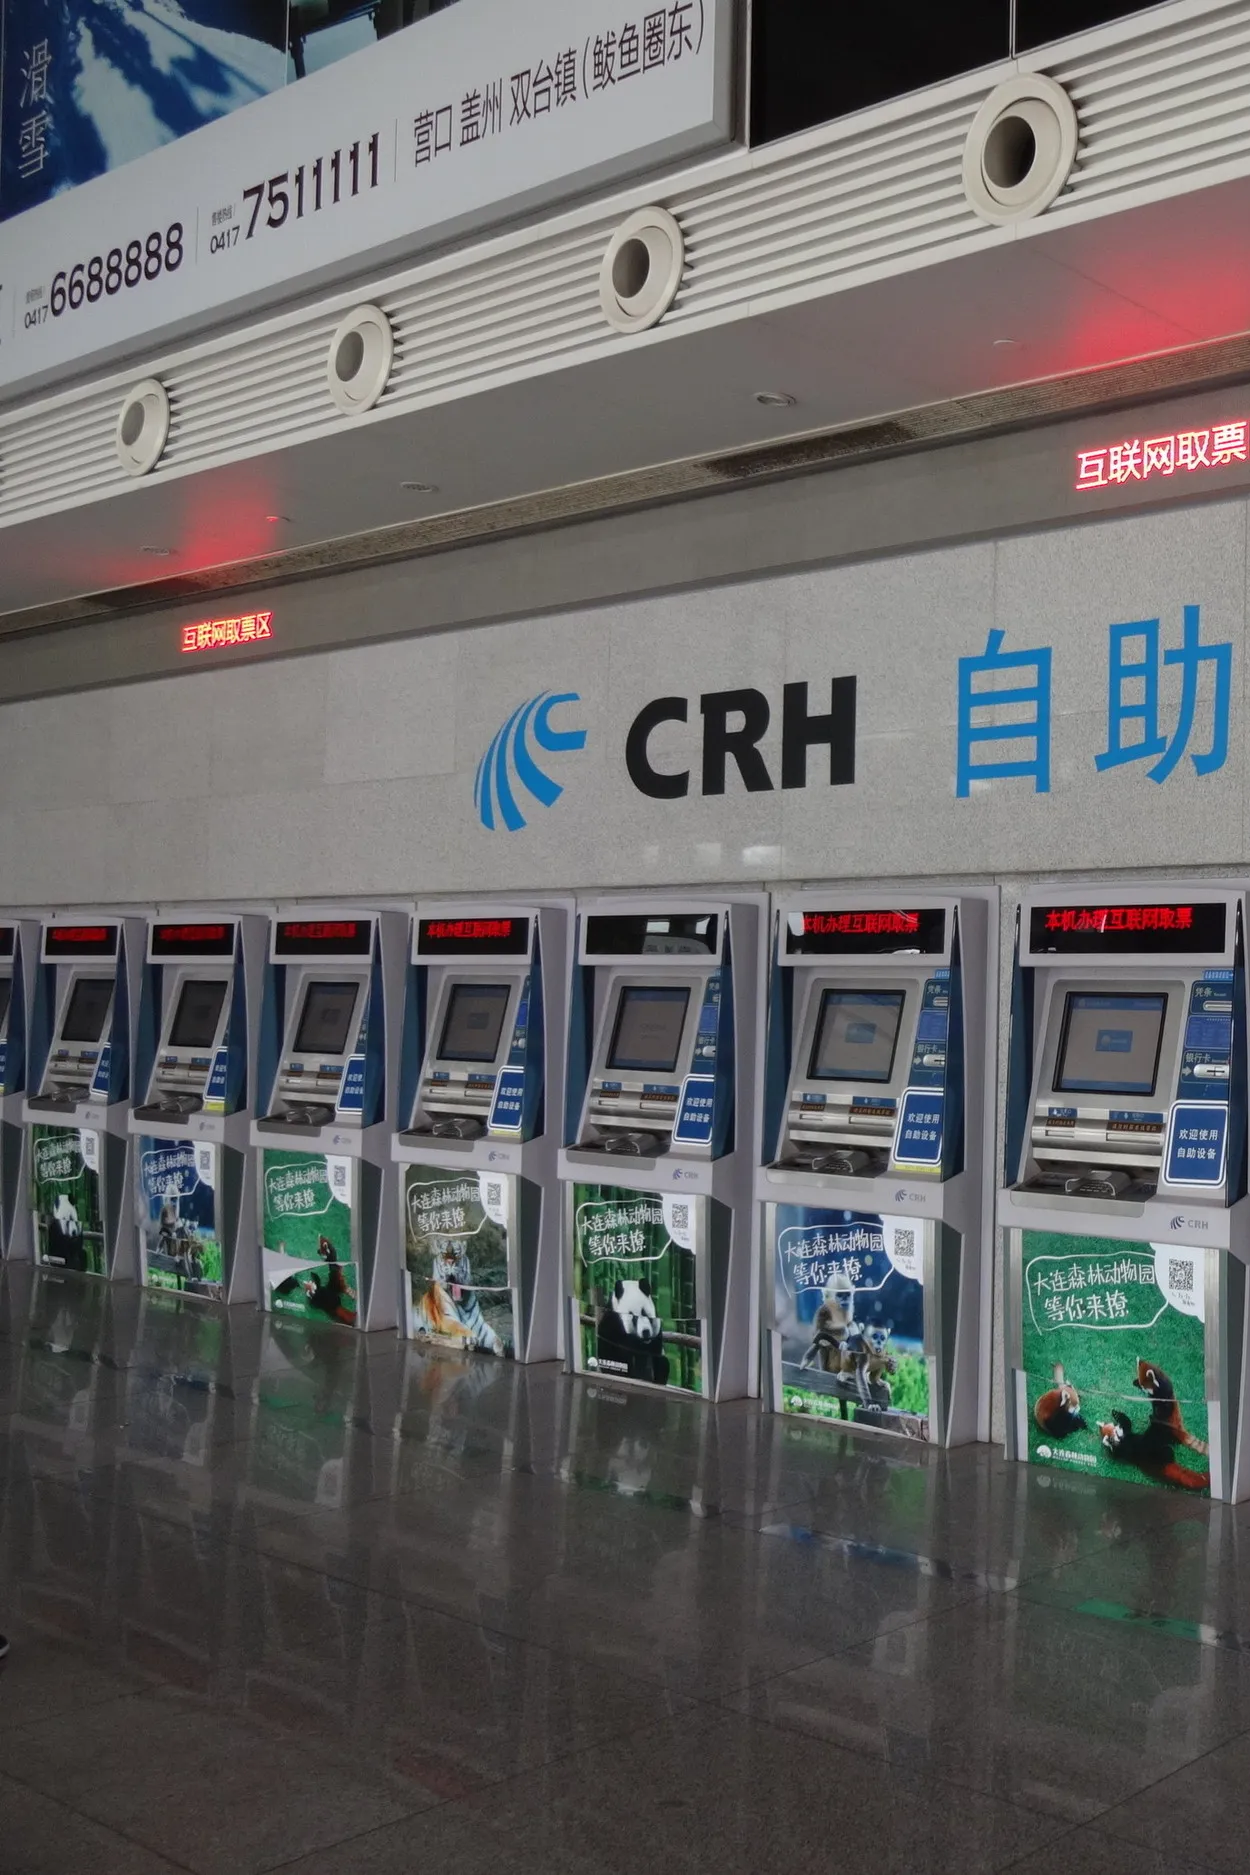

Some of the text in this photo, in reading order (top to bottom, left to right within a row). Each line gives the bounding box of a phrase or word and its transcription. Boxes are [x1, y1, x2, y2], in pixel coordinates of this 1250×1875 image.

[413, 105, 452, 167] 营口
[459, 77, 503, 147] 盖州
[210, 131, 380, 254] 0417 7511111
[24, 222, 184, 329] 0417 6688888
[181, 612, 271, 652] 互联网取票区
[625, 674, 857, 800] CRH
[1044, 907, 1193, 931] 本机办理互联网取票
[1185, 1052, 1211, 1063] 银行卡
[685, 1097, 714, 1108] 欢迎使用
[683, 1112, 711, 1123] 自助设备
[907, 1112, 940, 1125] 欢迎使用
[904, 1129, 937, 1141] 自助设备
[1178, 1128, 1219, 1142] 欢迎使用
[1176, 1146, 1217, 1160] 自助设备
[411, 1182, 481, 1213] 大连森林动物园
[908, 1192, 926, 1202] CRH
[417, 1206, 466, 1232] 等你来撩
[581, 1204, 664, 1235] 大连森林动物园
[1187, 1219, 1209, 1230] CRH
[588, 1228, 647, 1256] 等你来撩
[785, 1229, 884, 1262] 大连森林动物园
[793, 1256, 863, 1286] 等你来撩
[1033, 1258, 1156, 1296] 大连森林动物园
[1044, 1289, 1129, 1322] 等你来撩
